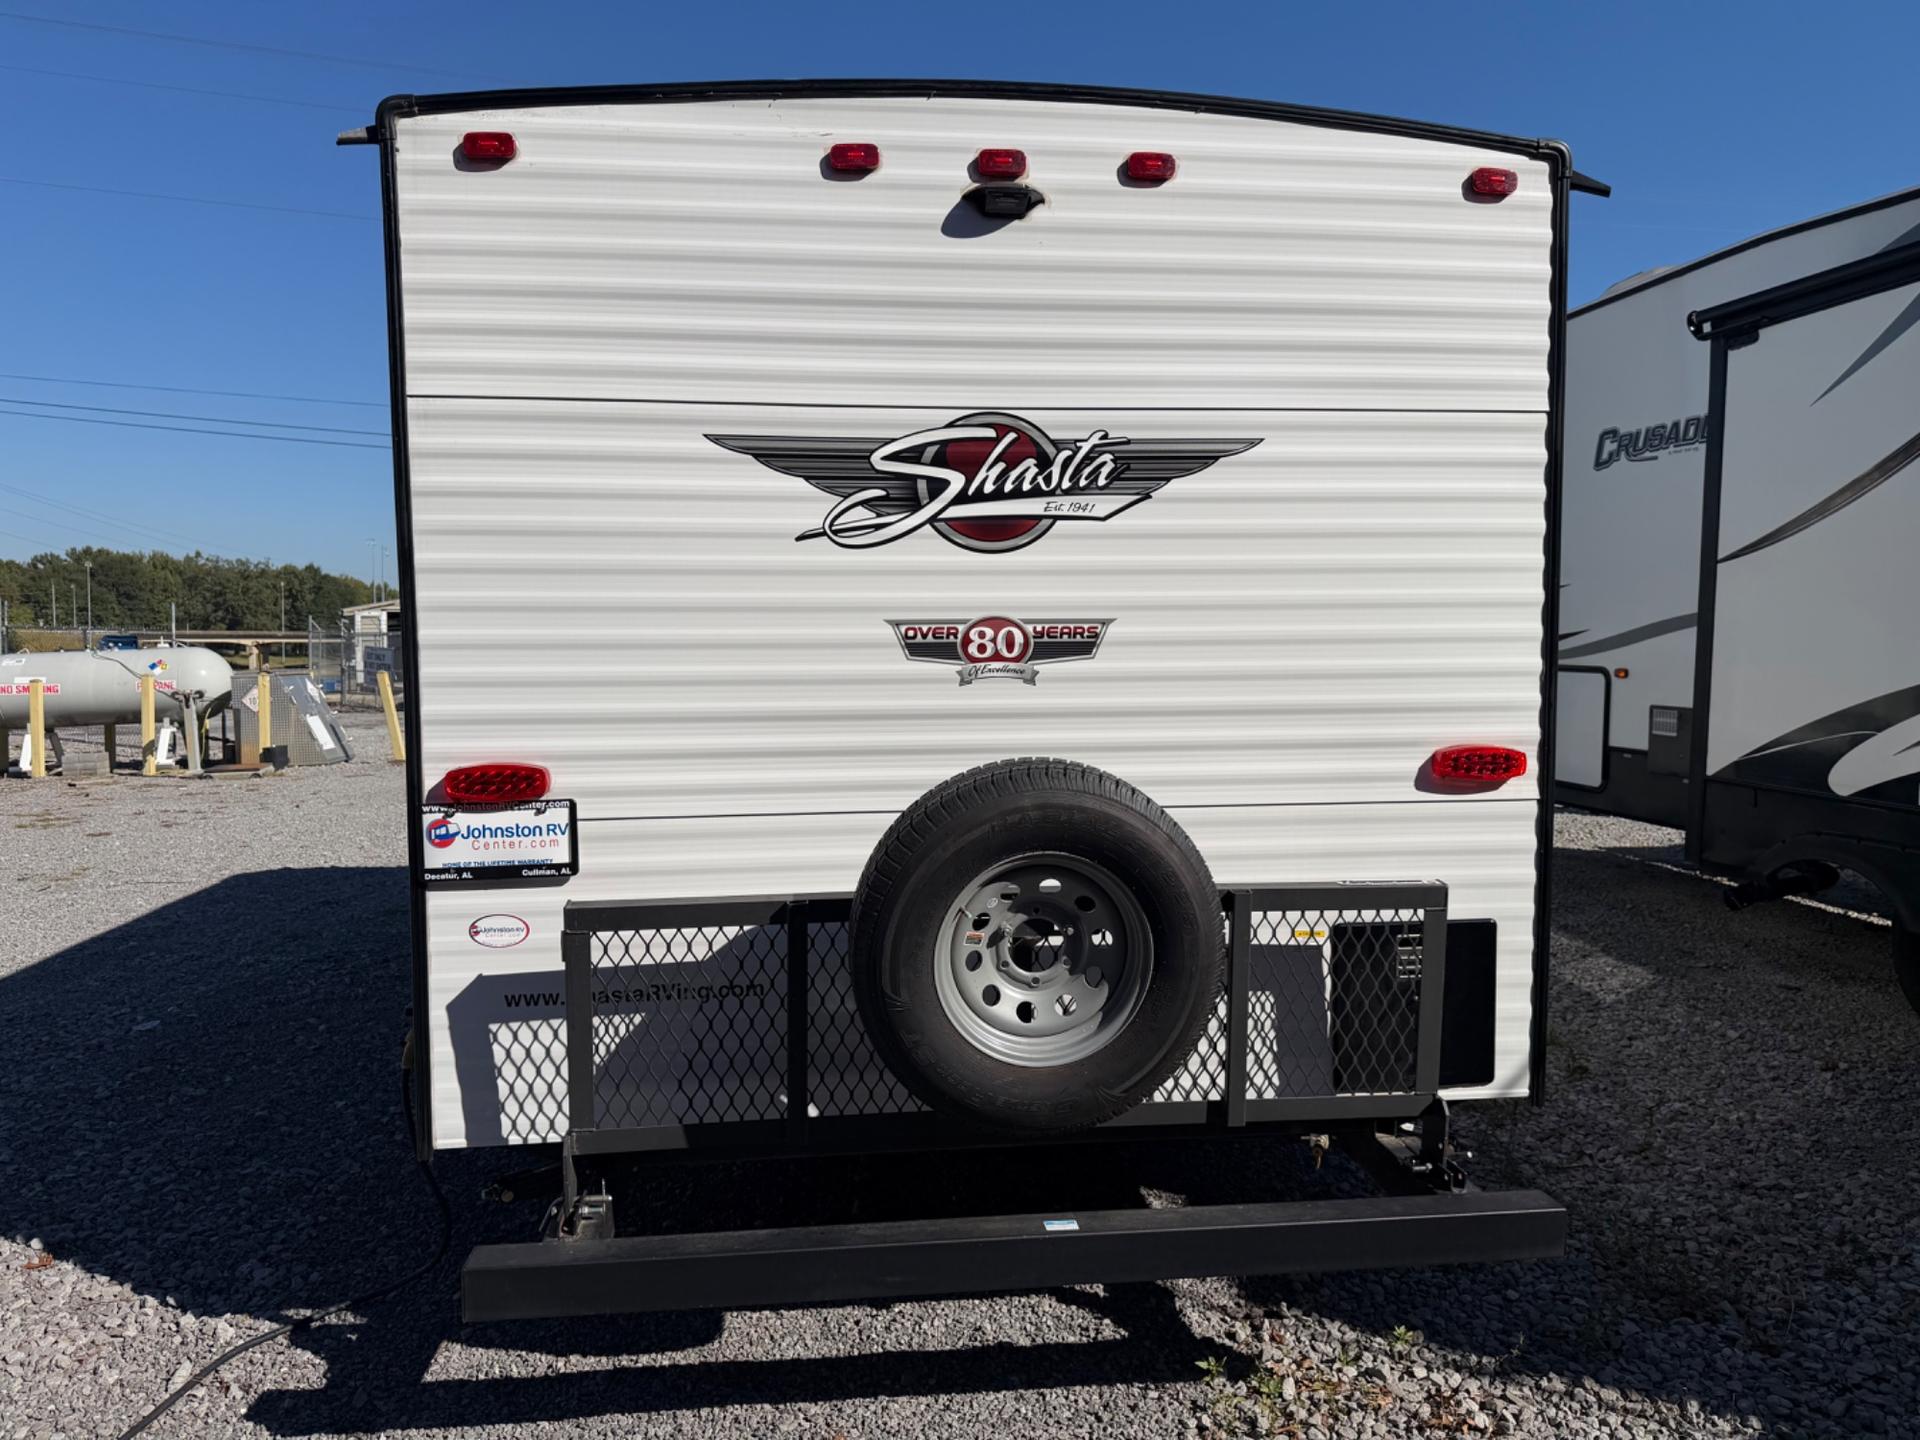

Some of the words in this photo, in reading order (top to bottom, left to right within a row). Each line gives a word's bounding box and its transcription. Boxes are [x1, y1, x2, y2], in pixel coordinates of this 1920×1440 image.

[797, 424, 1131, 549] Shasta
[1067, 502, 1096, 513] 1941
[904, 626, 959, 640] OVER
[967, 626, 1024, 659] 80
[1032, 625, 1100, 640] YEARS
[981, 663, 1026, 675] Excellence
[0, 685, 13, 694] NO
[15, 684, 60, 694] SMING
[136, 680, 176, 691] PPANE
[460, 823, 542, 840] Johnston
[546, 823, 569, 836] RV
[471, 838, 559, 851] Center.com
[462, 871, 473, 879] AL
[561, 867, 572, 875] AL
[504, 981, 765, 1007] www.astaRVing.com
